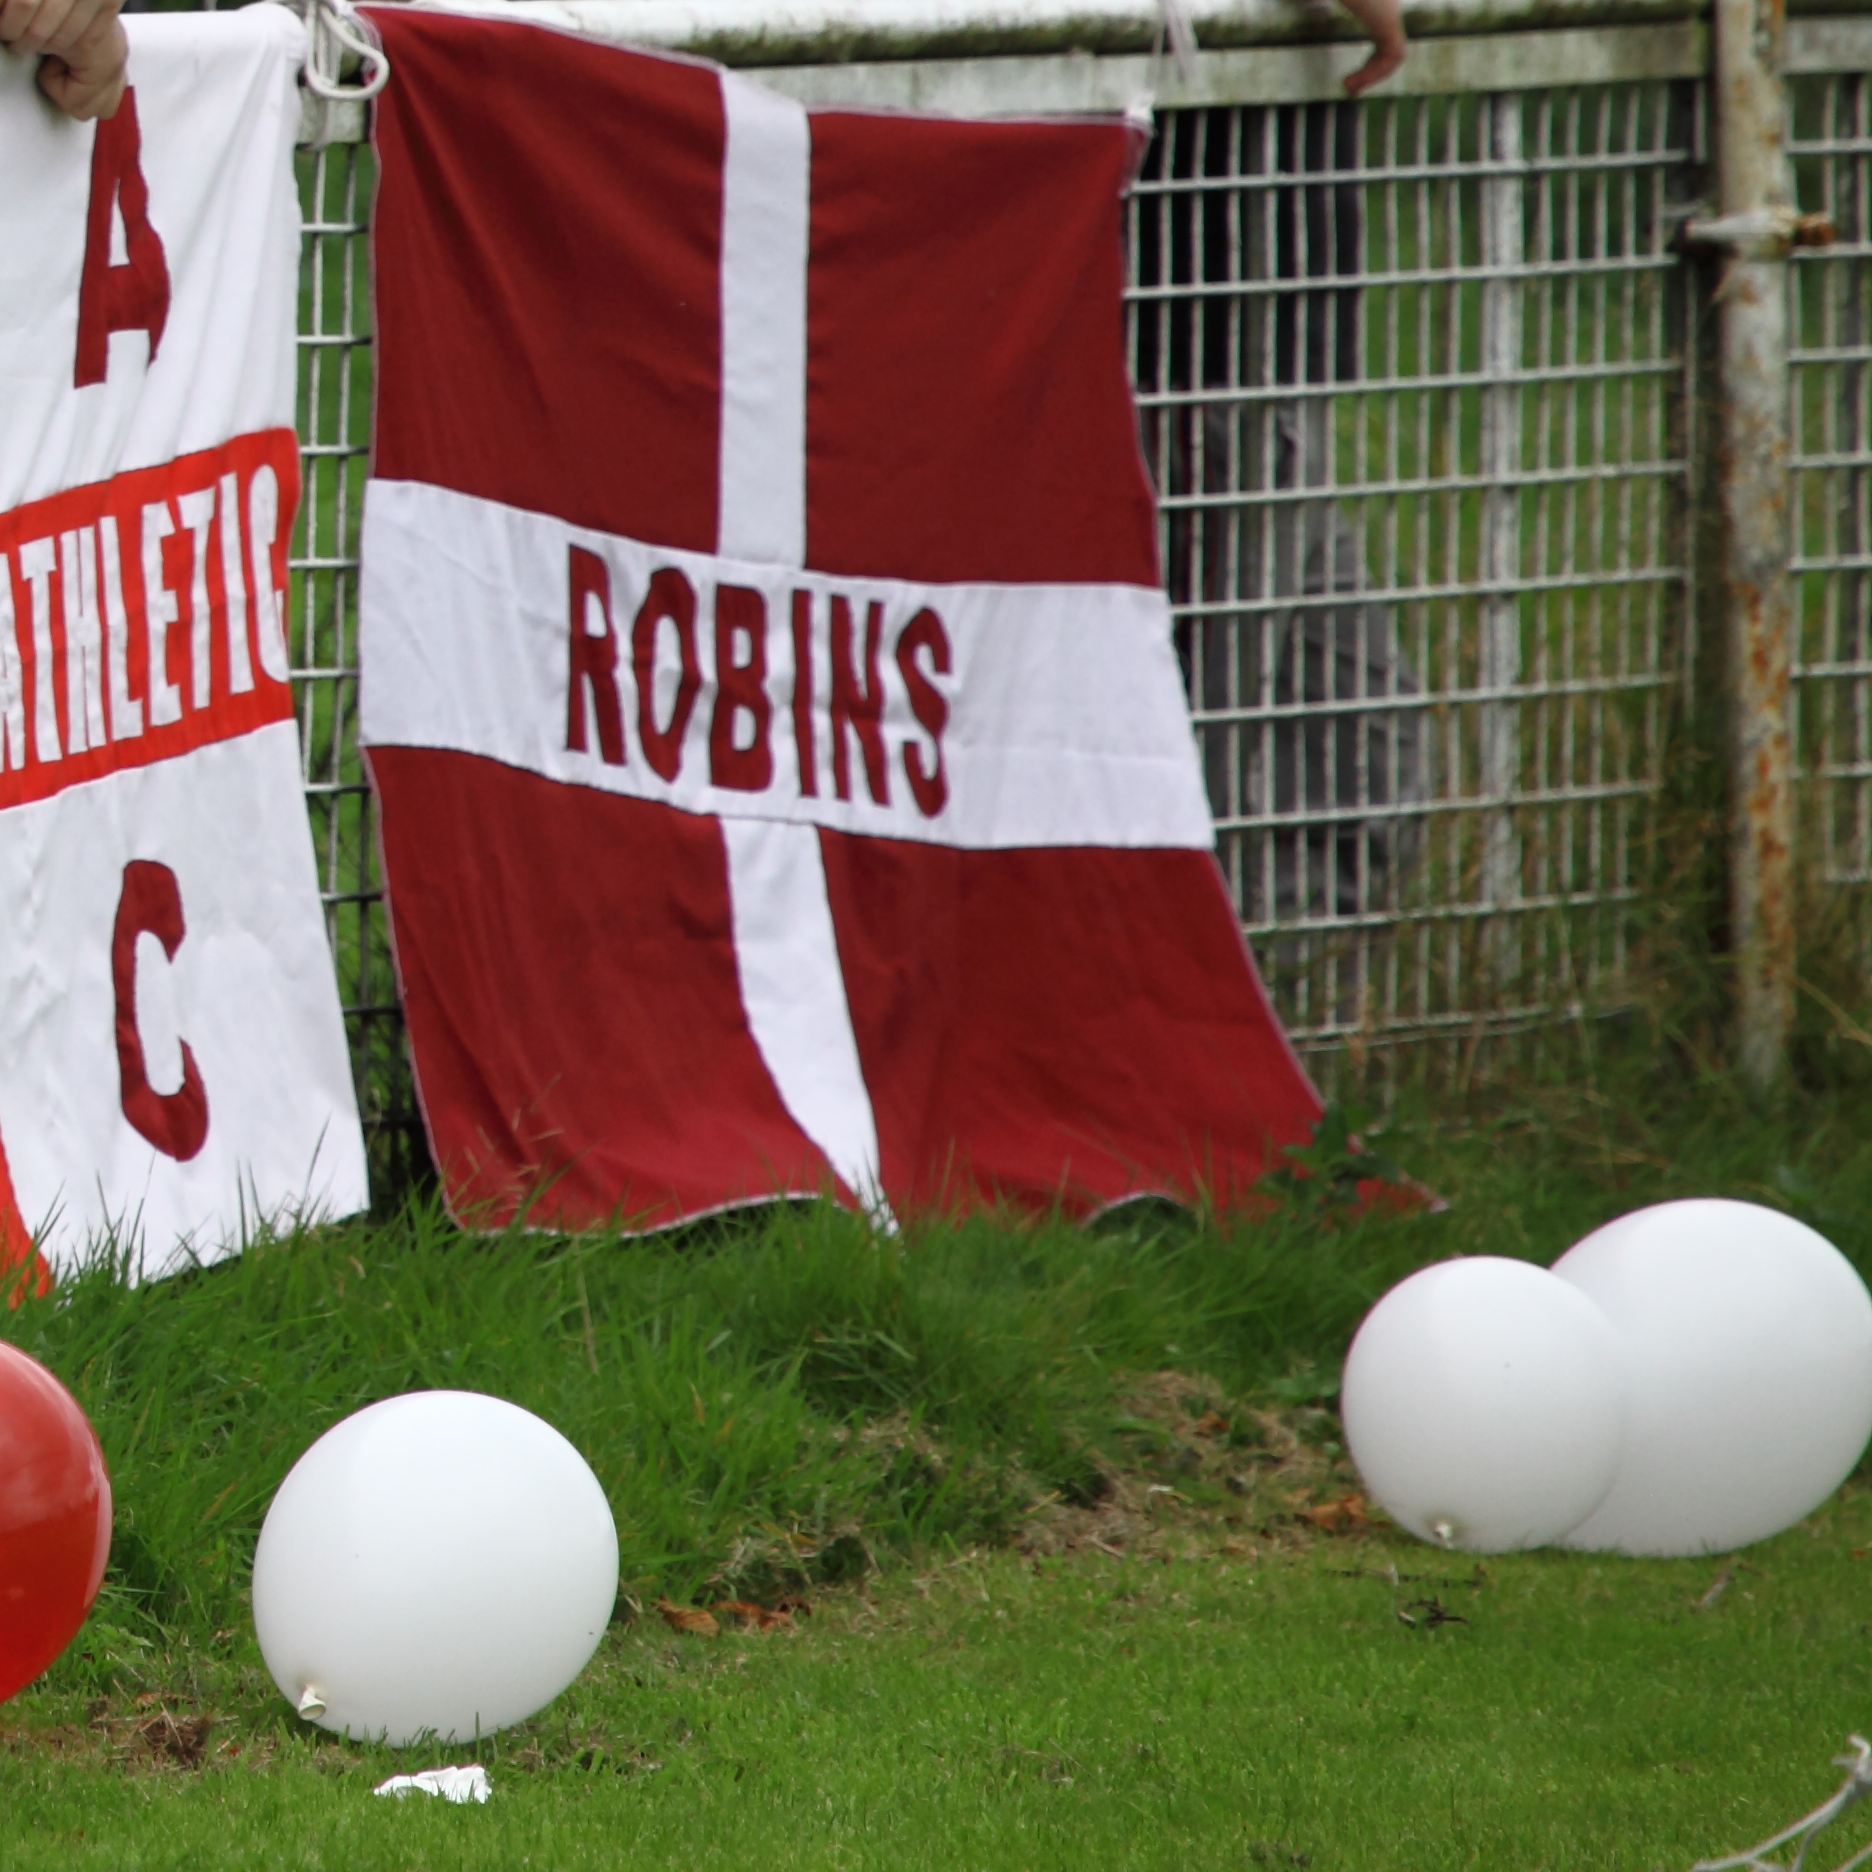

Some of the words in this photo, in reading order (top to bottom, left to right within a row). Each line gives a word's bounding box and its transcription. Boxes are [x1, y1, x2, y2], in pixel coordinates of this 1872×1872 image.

[73, 85, 171, 389] A
[566, 543, 954, 819] ROBINS
[111, 859, 209, 1162] C
